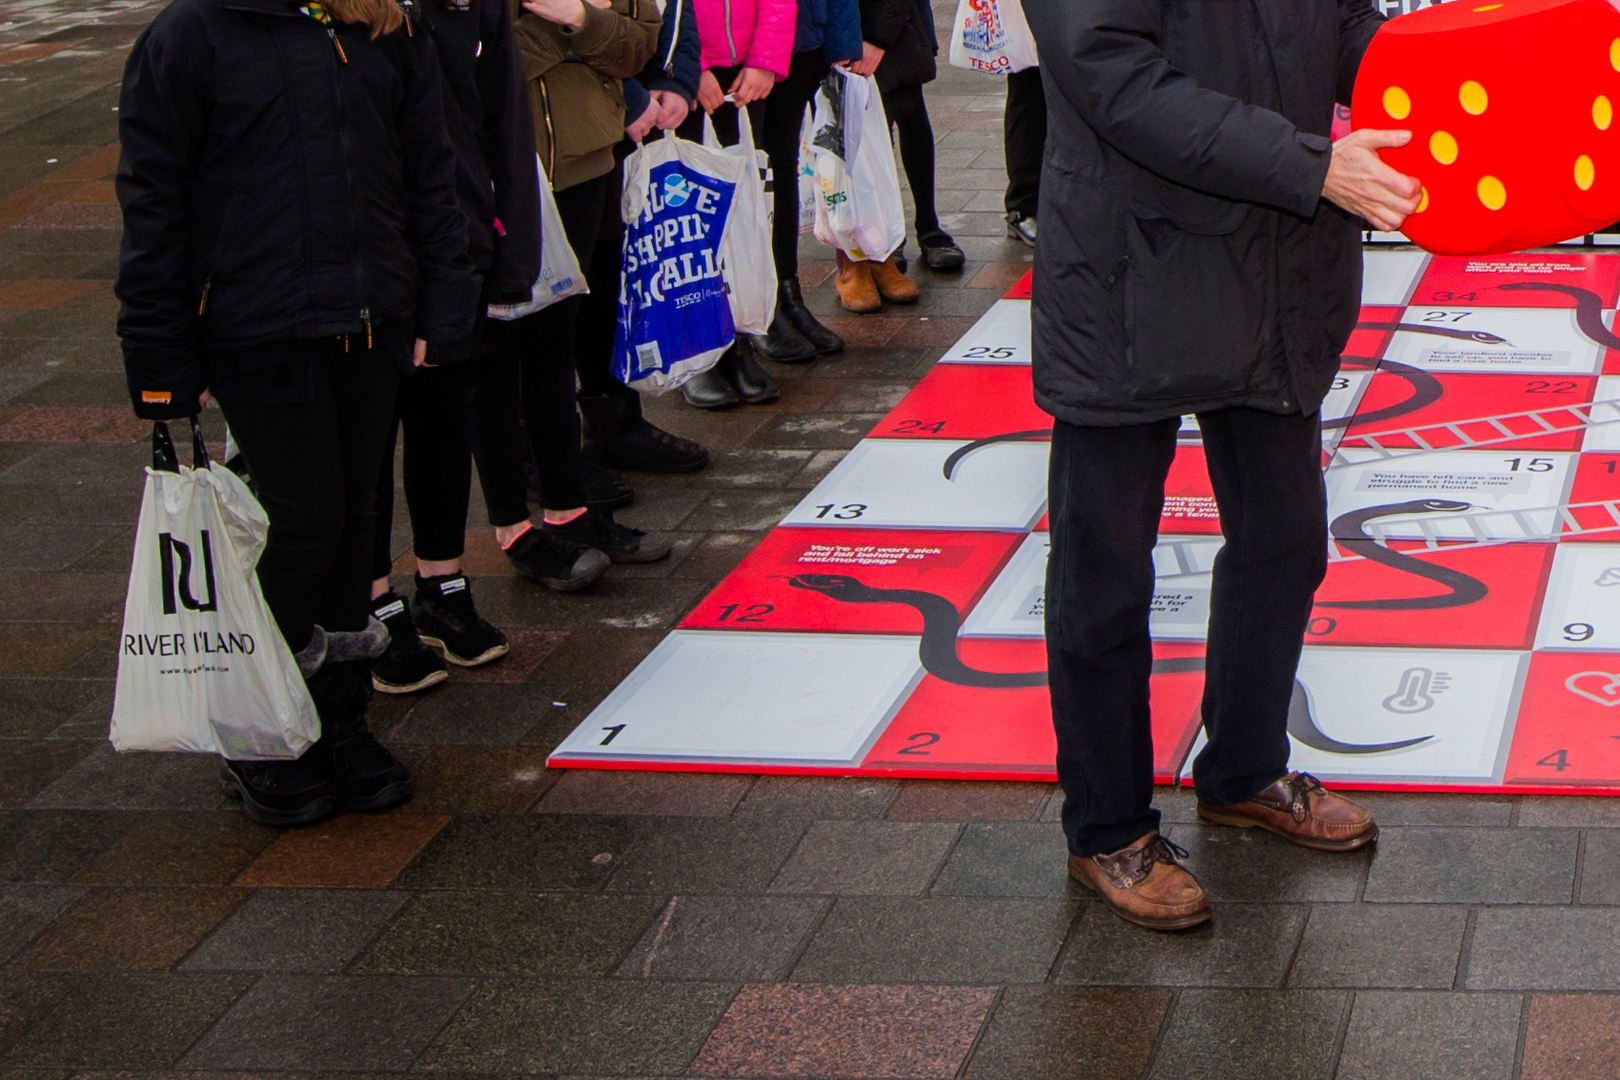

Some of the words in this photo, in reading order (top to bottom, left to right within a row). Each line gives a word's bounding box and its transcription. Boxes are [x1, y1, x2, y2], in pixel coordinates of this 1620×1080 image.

[969, 56, 1009, 71] TESCO
[674, 291, 702, 305] TESCO
[1431, 292, 1478, 301] 34
[1422, 311, 1472, 322] 27
[962, 347, 1014, 359] 25
[1523, 382, 1578, 394] 22
[890, 421, 945, 433] 24
[1504, 458, 1554, 472] 15
[814, 504, 867, 519] 13
[715, 605, 774, 622] 12
[1563, 623, 1595, 641] 9
[124, 634, 186, 656] RIVER
[193, 631, 255, 655] ILAND
[600, 725, 628, 745] 1
[898, 733, 942, 755] 2
[1536, 749, 1572, 772] 4
